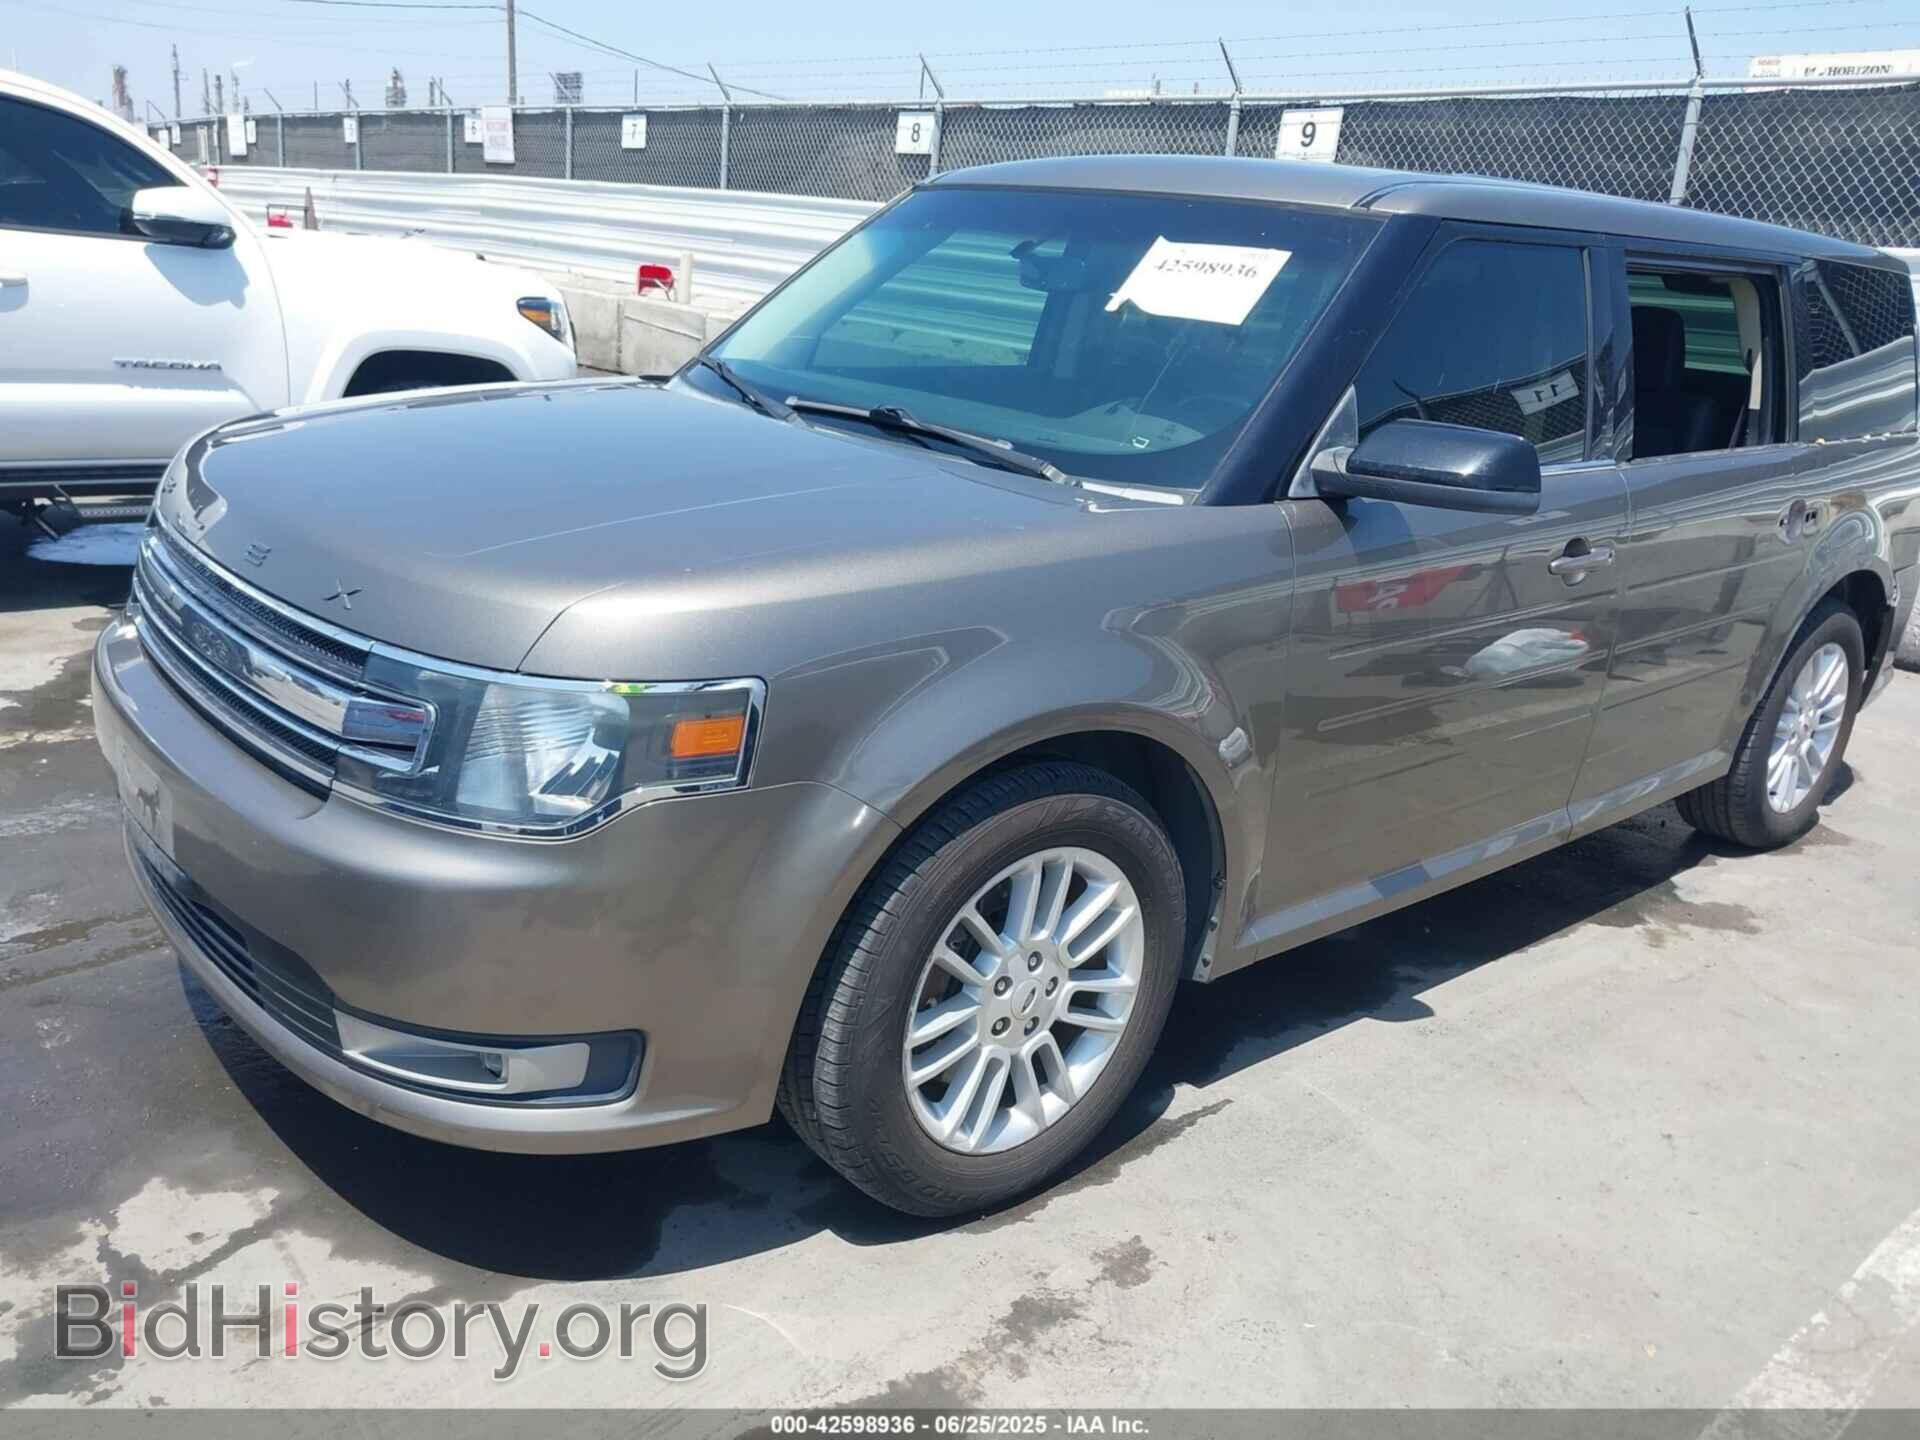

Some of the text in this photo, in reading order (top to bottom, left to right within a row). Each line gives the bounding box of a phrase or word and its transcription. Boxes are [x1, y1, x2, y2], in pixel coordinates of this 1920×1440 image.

[911, 122, 921, 143] 8
[1300, 121, 1317, 148] 9
[1155, 258, 1258, 280] 42598936
